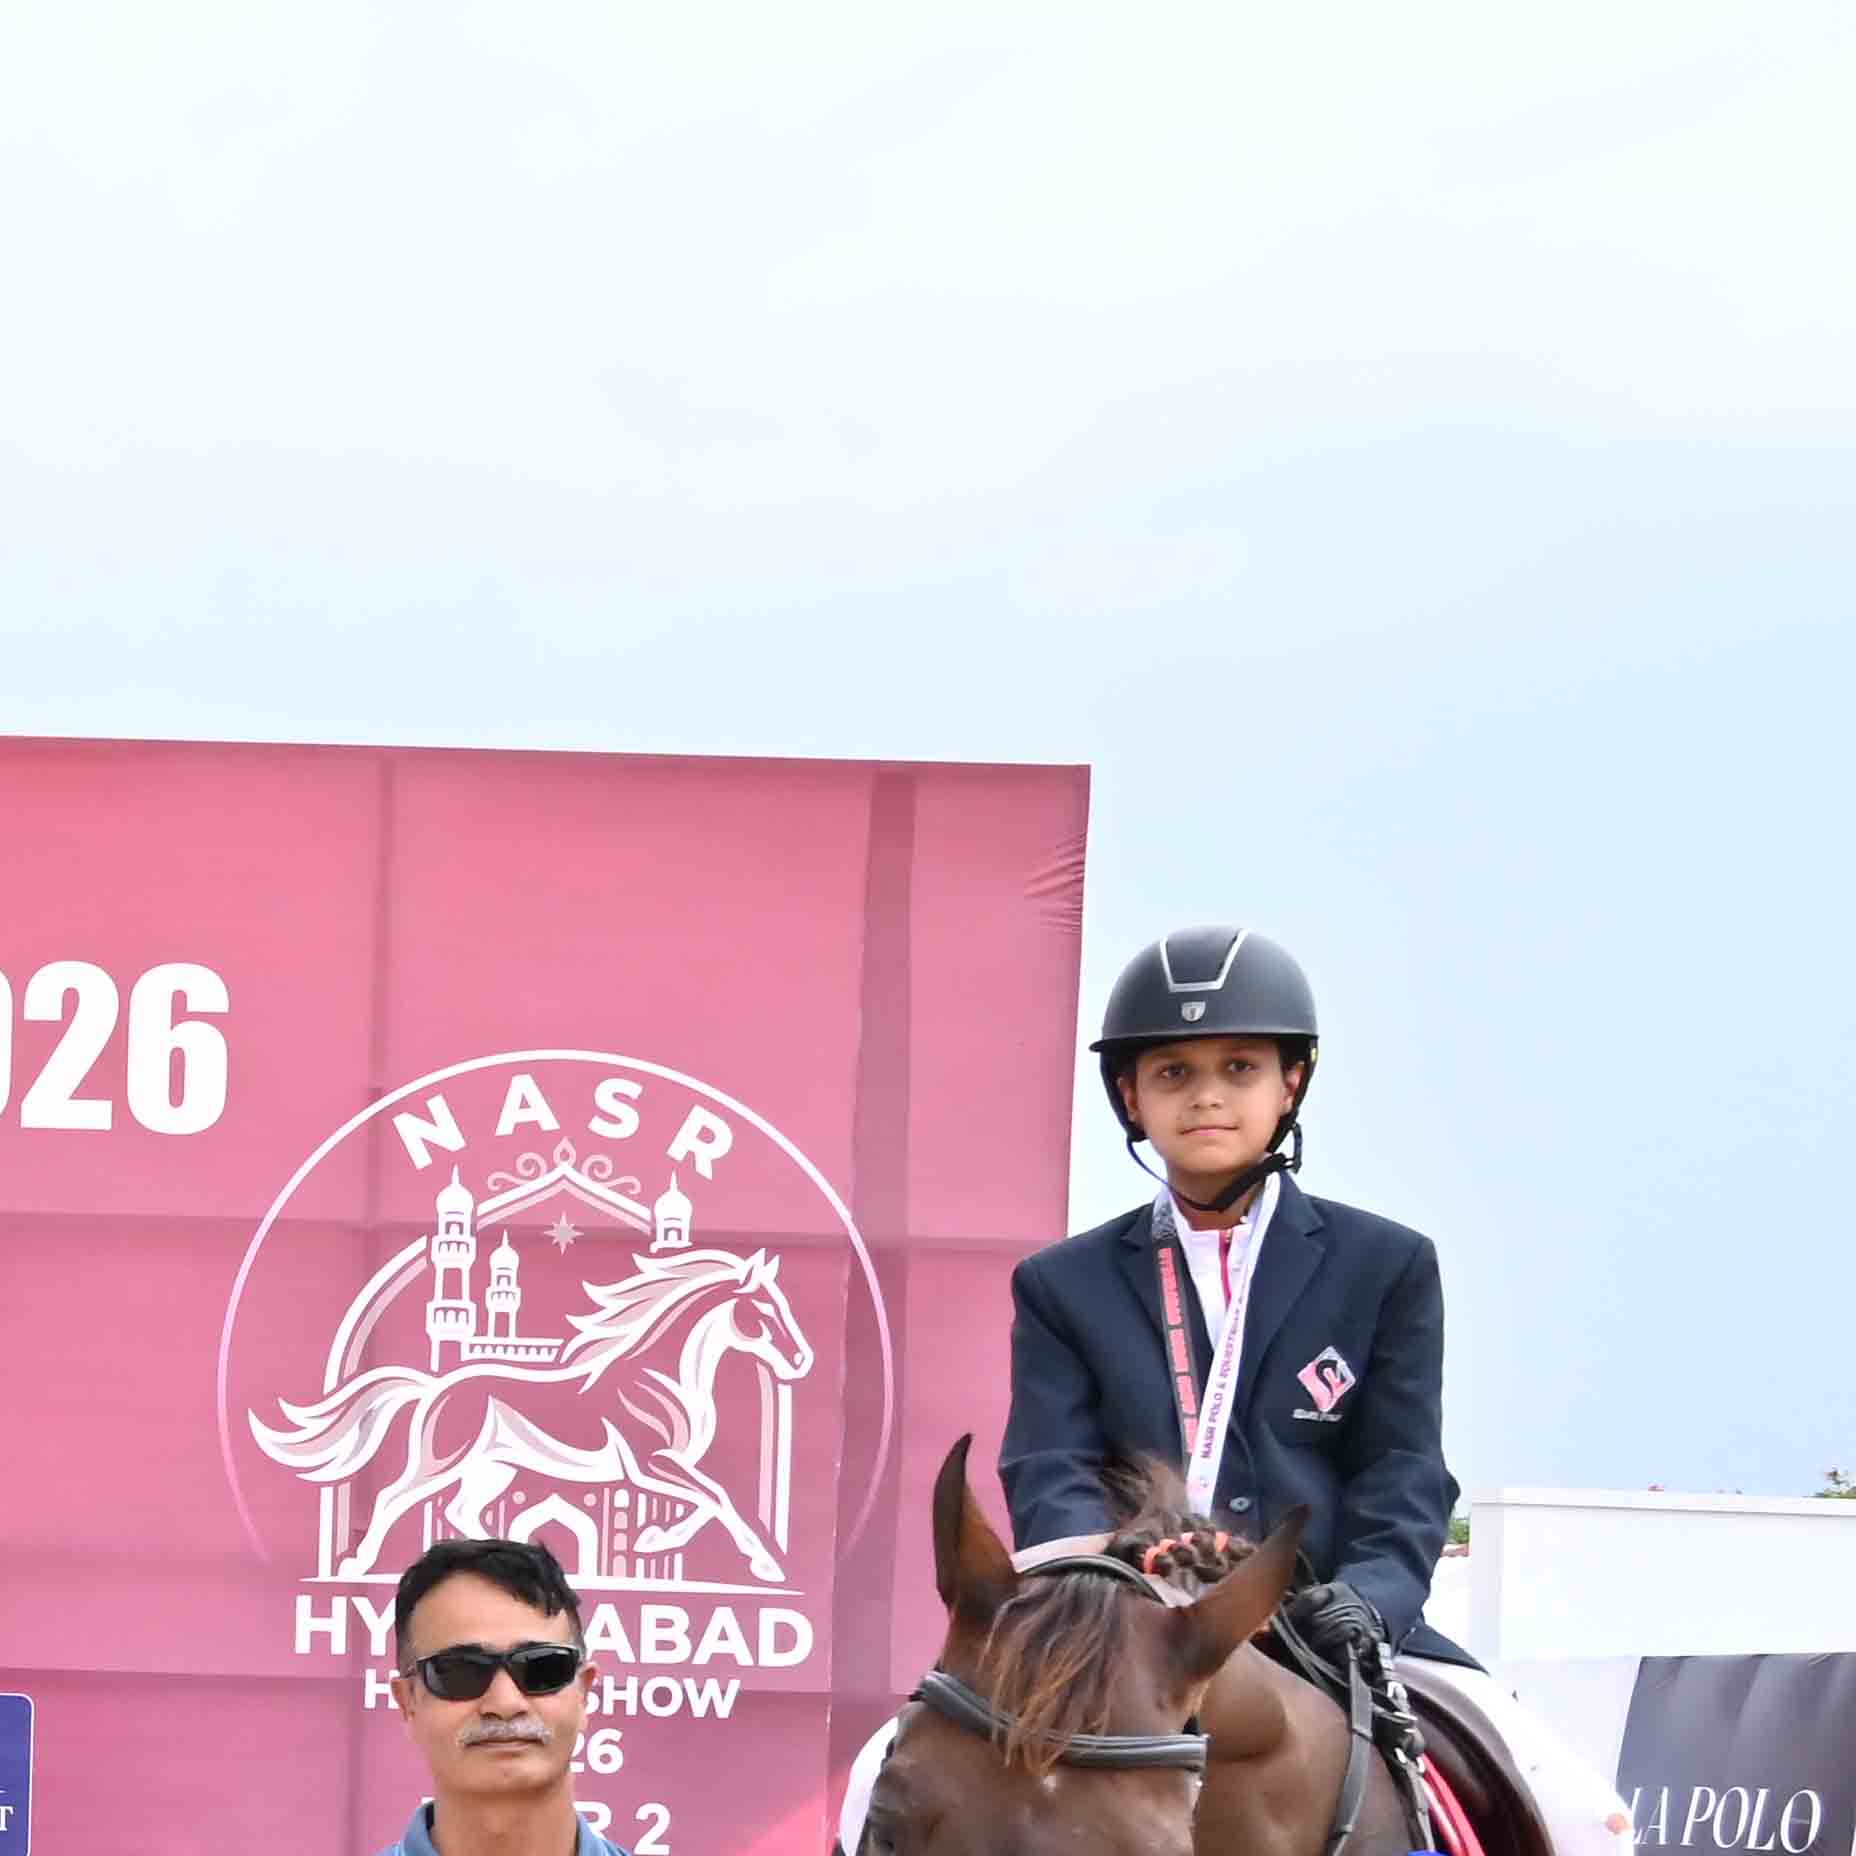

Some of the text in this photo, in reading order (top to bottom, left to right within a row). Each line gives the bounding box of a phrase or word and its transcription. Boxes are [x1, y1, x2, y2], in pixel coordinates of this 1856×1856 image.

[392, 1073, 734, 1181] NASR
[294, 1595, 813, 1668] HYABAD
[633, 1802, 671, 1856] 2
[1680, 1786, 1822, 1853] POLO
